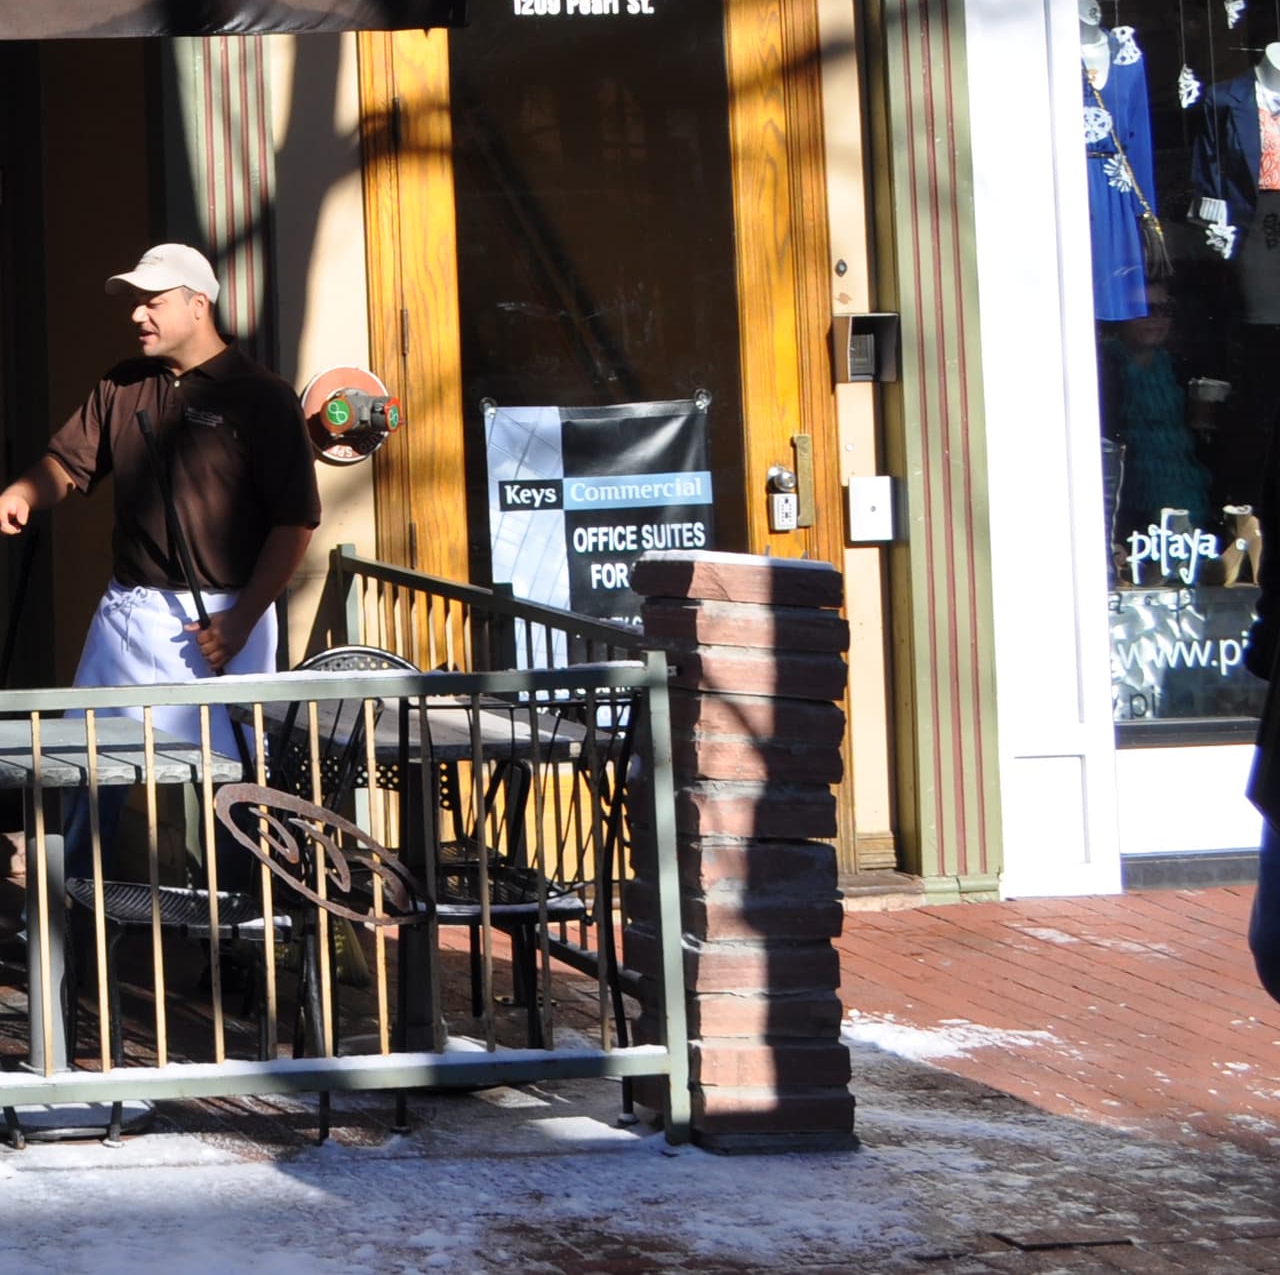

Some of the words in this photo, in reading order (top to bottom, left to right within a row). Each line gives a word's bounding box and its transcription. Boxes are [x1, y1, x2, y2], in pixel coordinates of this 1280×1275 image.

[505, 485, 557, 507] Keys
[570, 477, 702, 502] Commercial
[573, 525, 637, 553] OFFICE
[641, 522, 706, 550] SUITES
[1126, 508, 1220, 585] pitaya
[591, 563, 629, 589] FOR
